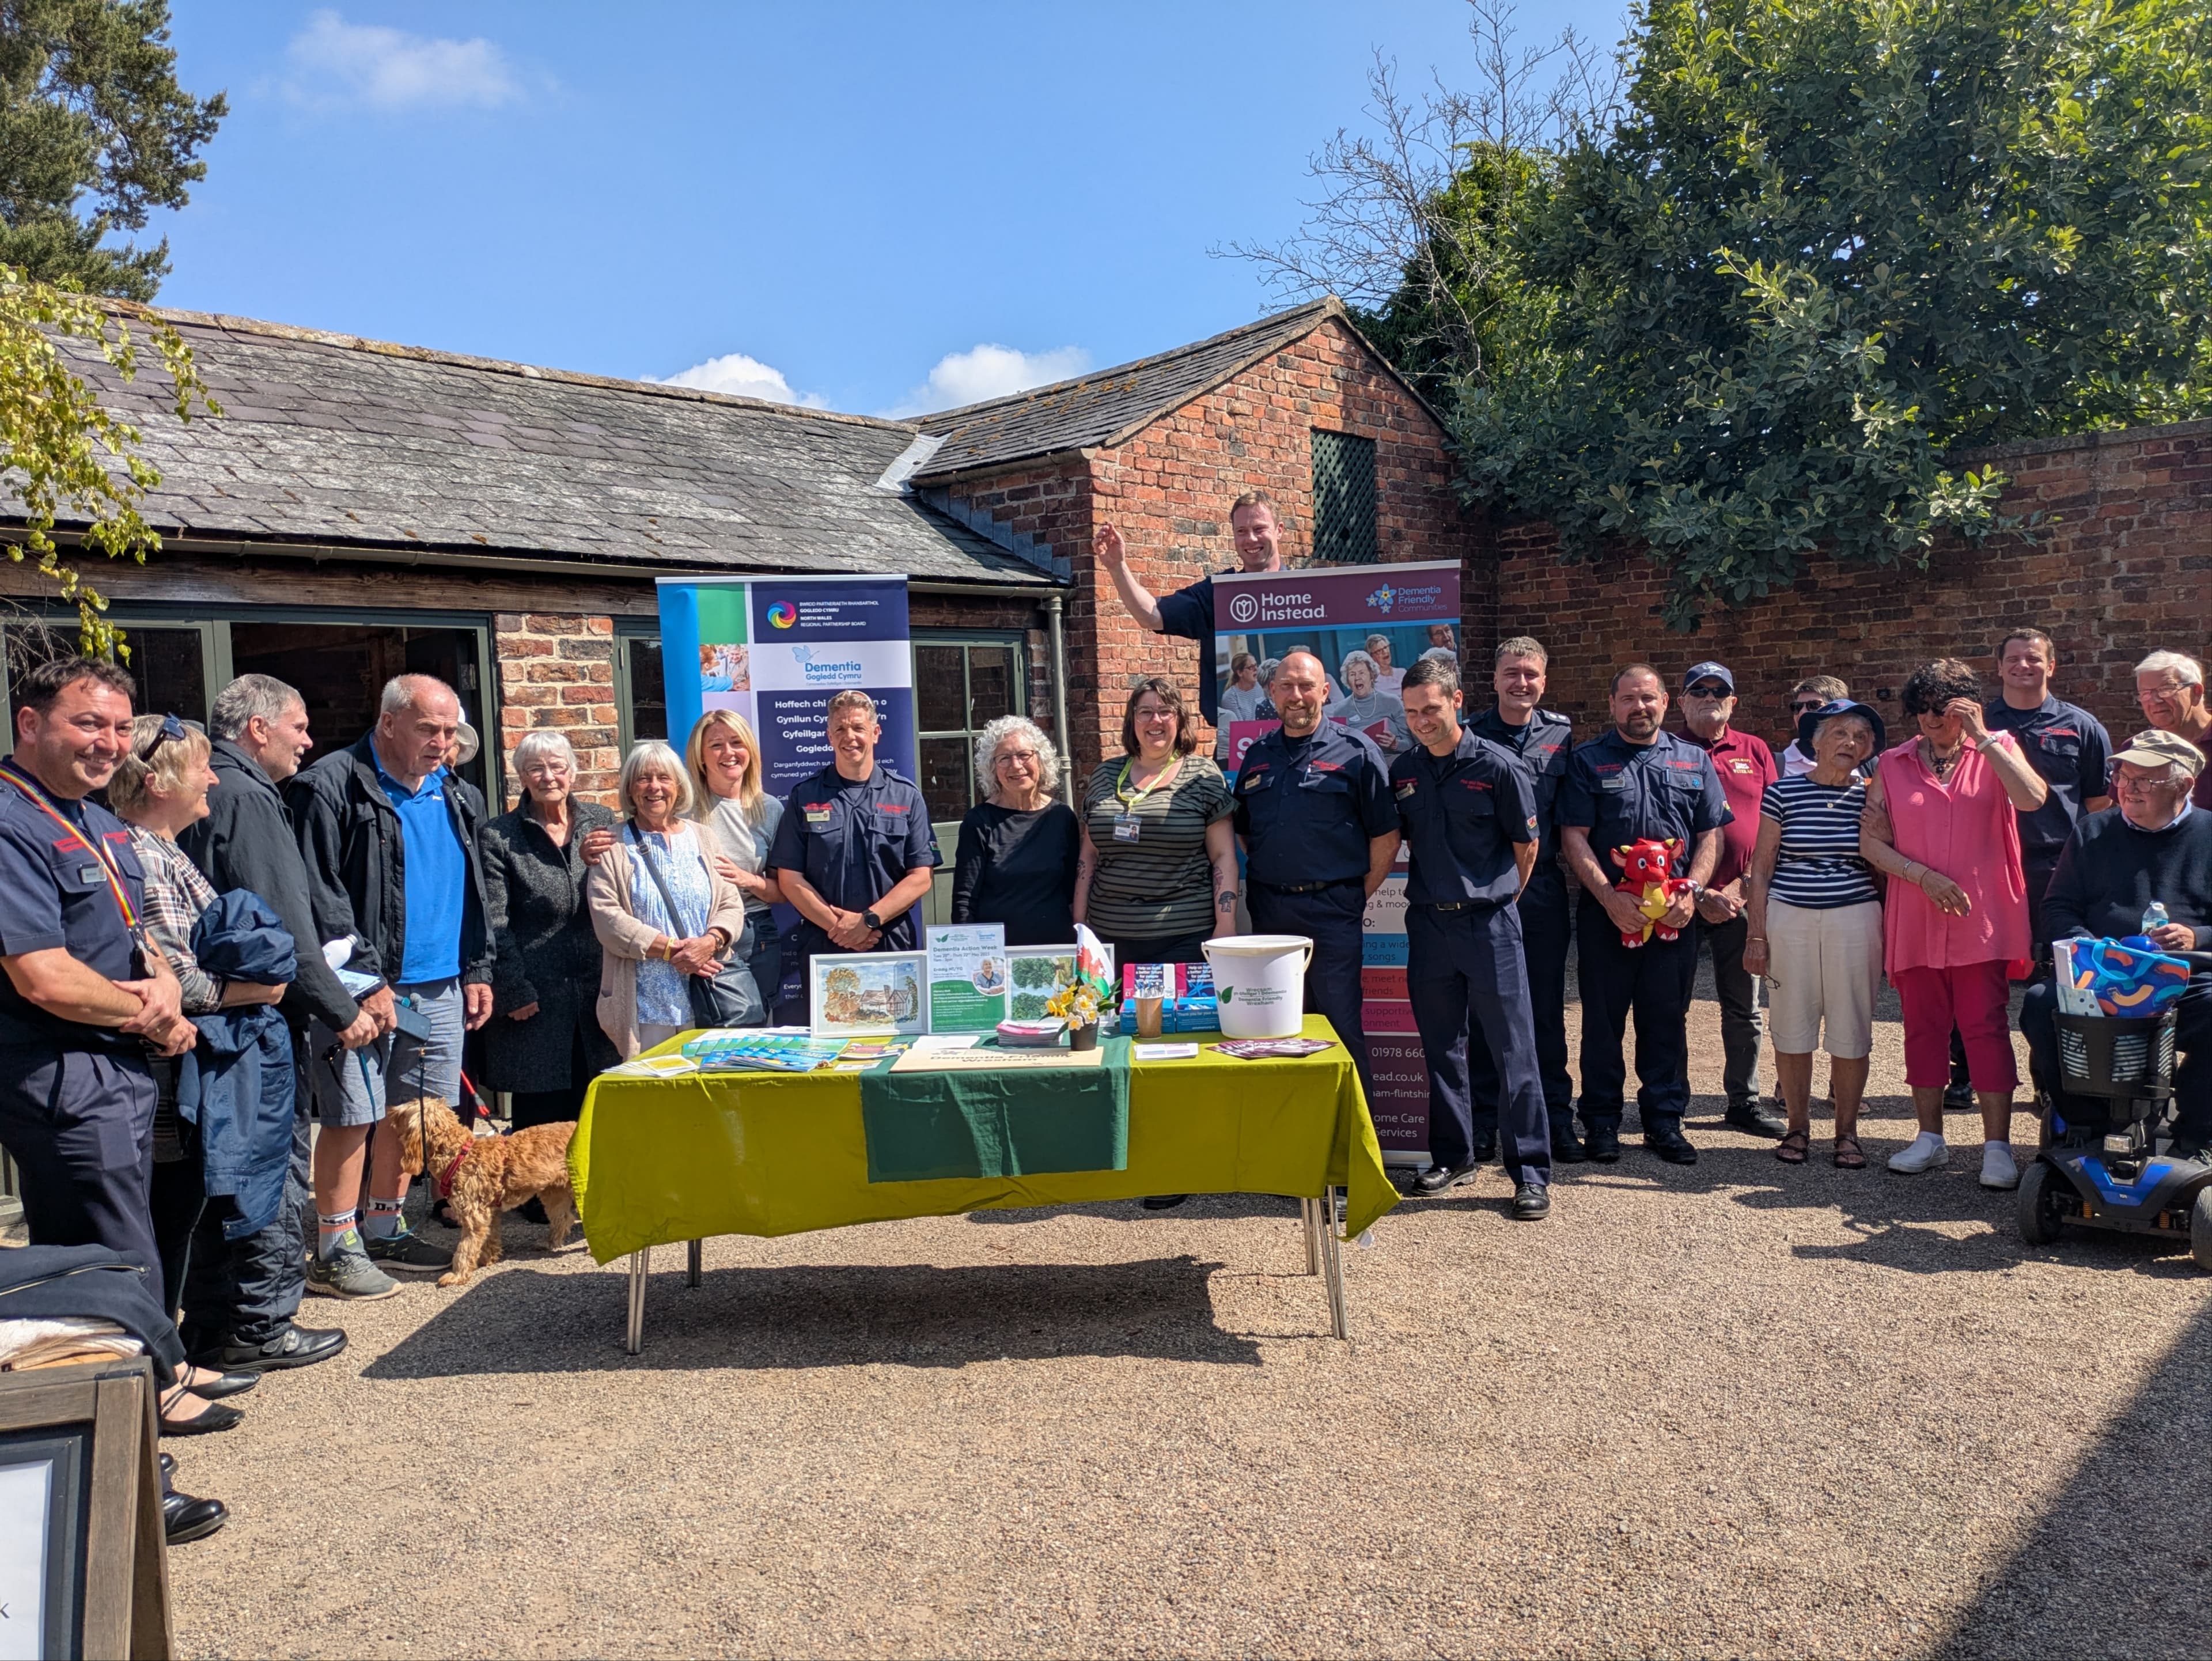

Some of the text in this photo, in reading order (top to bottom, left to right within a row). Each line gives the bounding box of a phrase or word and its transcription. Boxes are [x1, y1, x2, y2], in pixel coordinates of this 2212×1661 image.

[1398, 585, 1441, 596] Dementia
[1262, 592, 1312, 607] Home
[1398, 595, 1435, 604] Friendly
[1398, 604, 1448, 613] Communities
[805, 660, 861, 672] Dementia
[806, 672, 862, 681] Gogledd Cymru
[775, 699, 827, 709] Hoffech chi
[777, 715, 811, 725] Gynllun
[782, 729, 826, 740] Gyfeillgar
[774, 761, 821, 769] Darganfyddwch
[1376, 900, 1383, 908] &
[1368, 954, 1396, 962] songs
[1372, 975, 1397, 983] meet
[1371, 1047, 1402, 1057] 01978
[1373, 1113, 1425, 1123] ome Care
